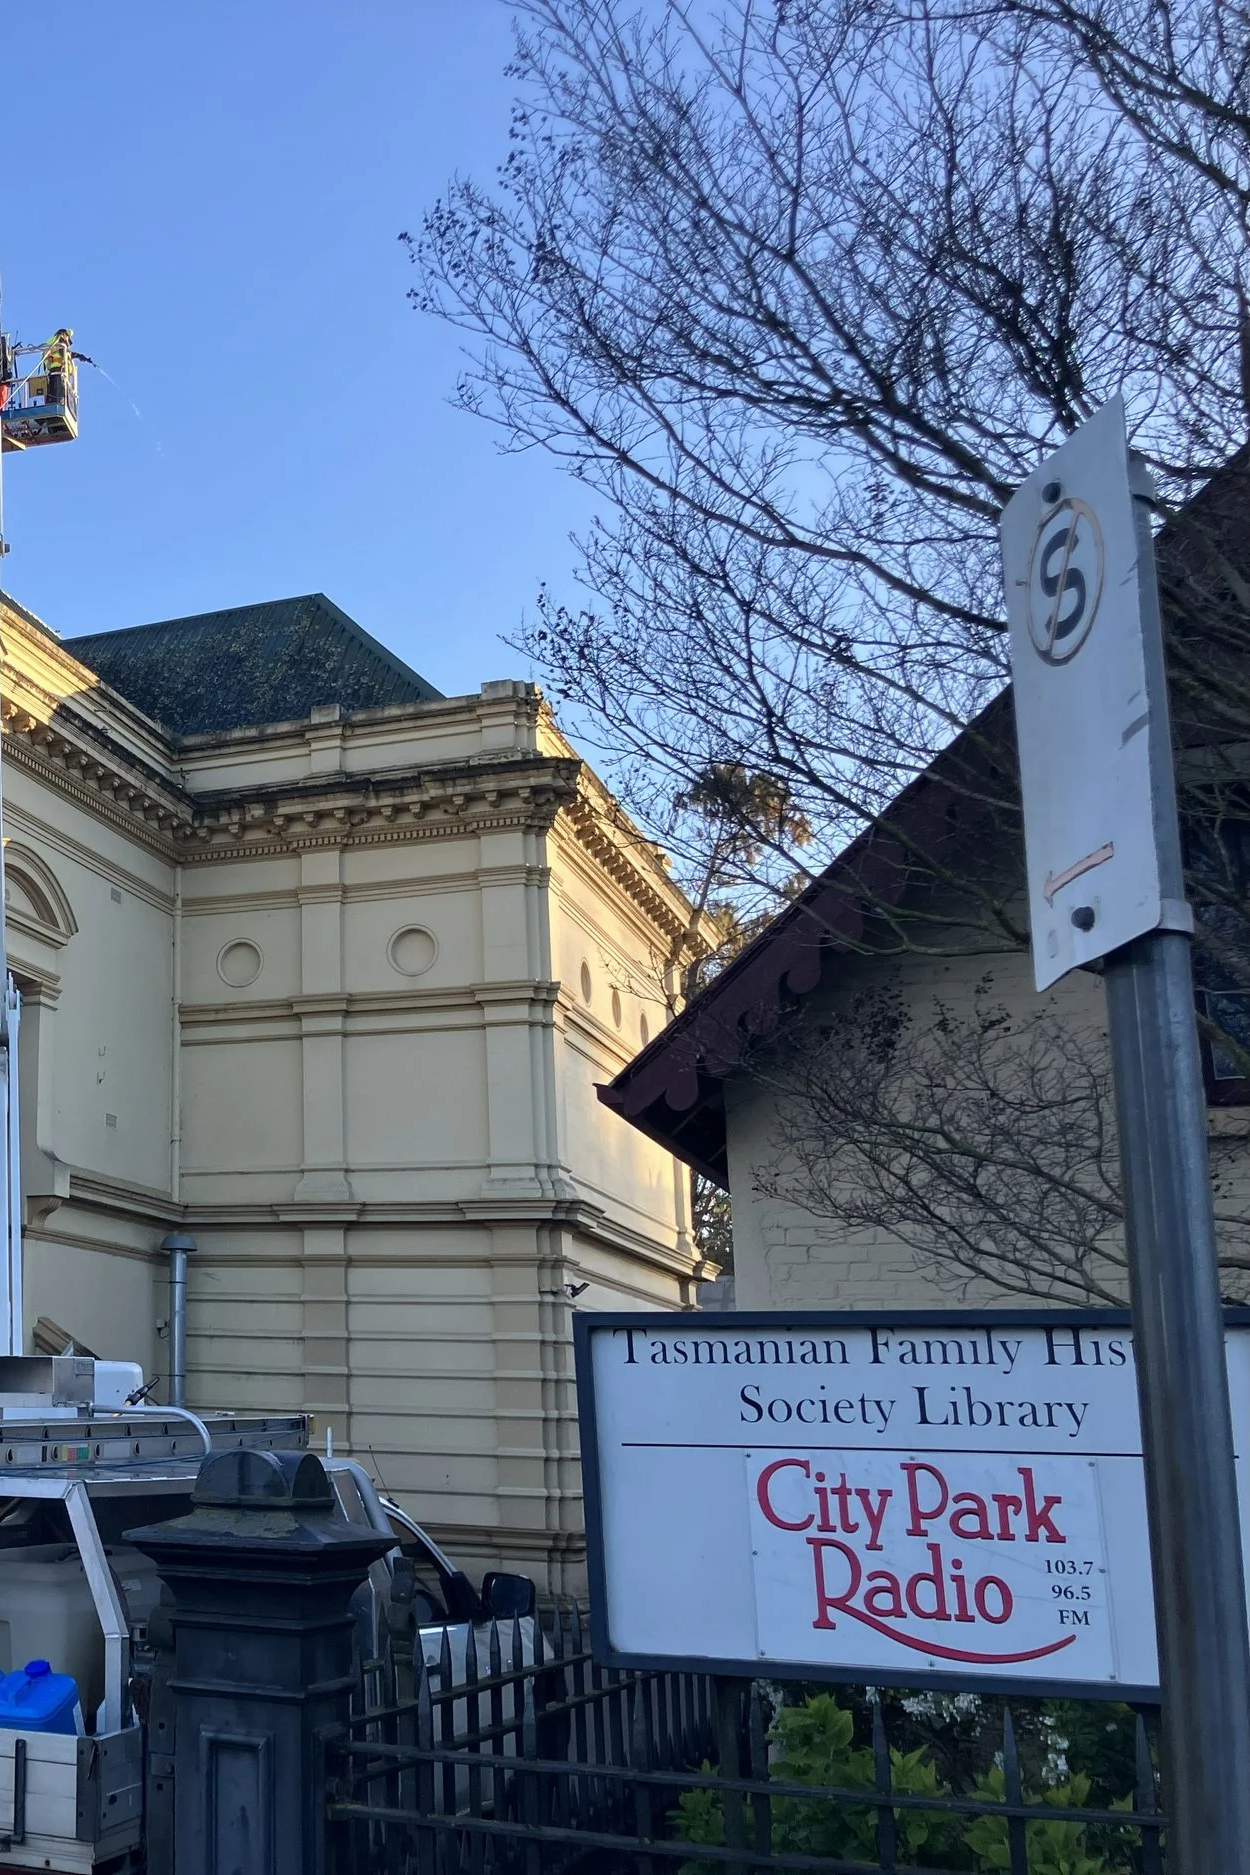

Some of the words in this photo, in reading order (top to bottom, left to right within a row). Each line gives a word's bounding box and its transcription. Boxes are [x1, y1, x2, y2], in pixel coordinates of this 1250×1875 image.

[1040, 527, 1087, 641] S
[613, 1327, 850, 1366] Tasmanian
[867, 1326, 1023, 1375] Family
[1040, 1326, 1136, 1367] His
[740, 1384, 897, 1434] Society
[912, 1386, 1090, 1438] Library
[757, 1458, 893, 1551] City
[900, 1462, 1067, 1544] Park
[1045, 1559, 1094, 1576] 103.7
[1052, 1584, 1091, 1601] 96.5
[806, 1537, 1077, 1664] Radio
[1059, 1609, 1091, 1627] FM
